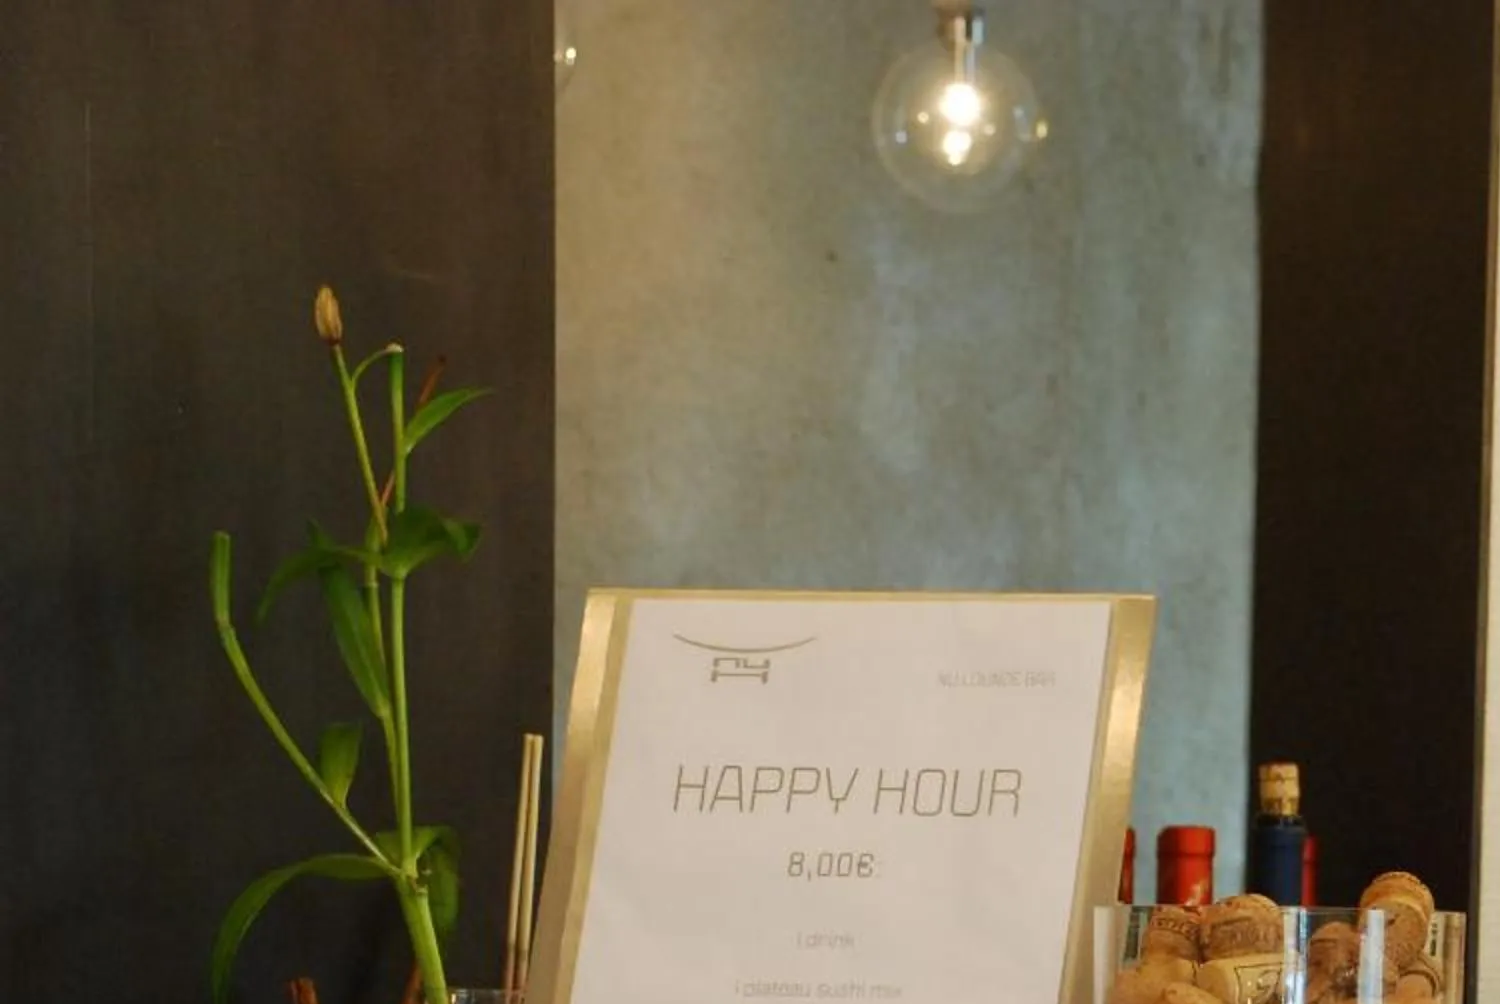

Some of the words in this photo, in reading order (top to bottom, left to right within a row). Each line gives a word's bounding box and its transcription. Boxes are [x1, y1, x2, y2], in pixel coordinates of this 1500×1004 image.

[674, 764, 859, 815] HAPPY
[873, 768, 1023, 817] HOUR
[787, 851, 875, 882] 8,00€
